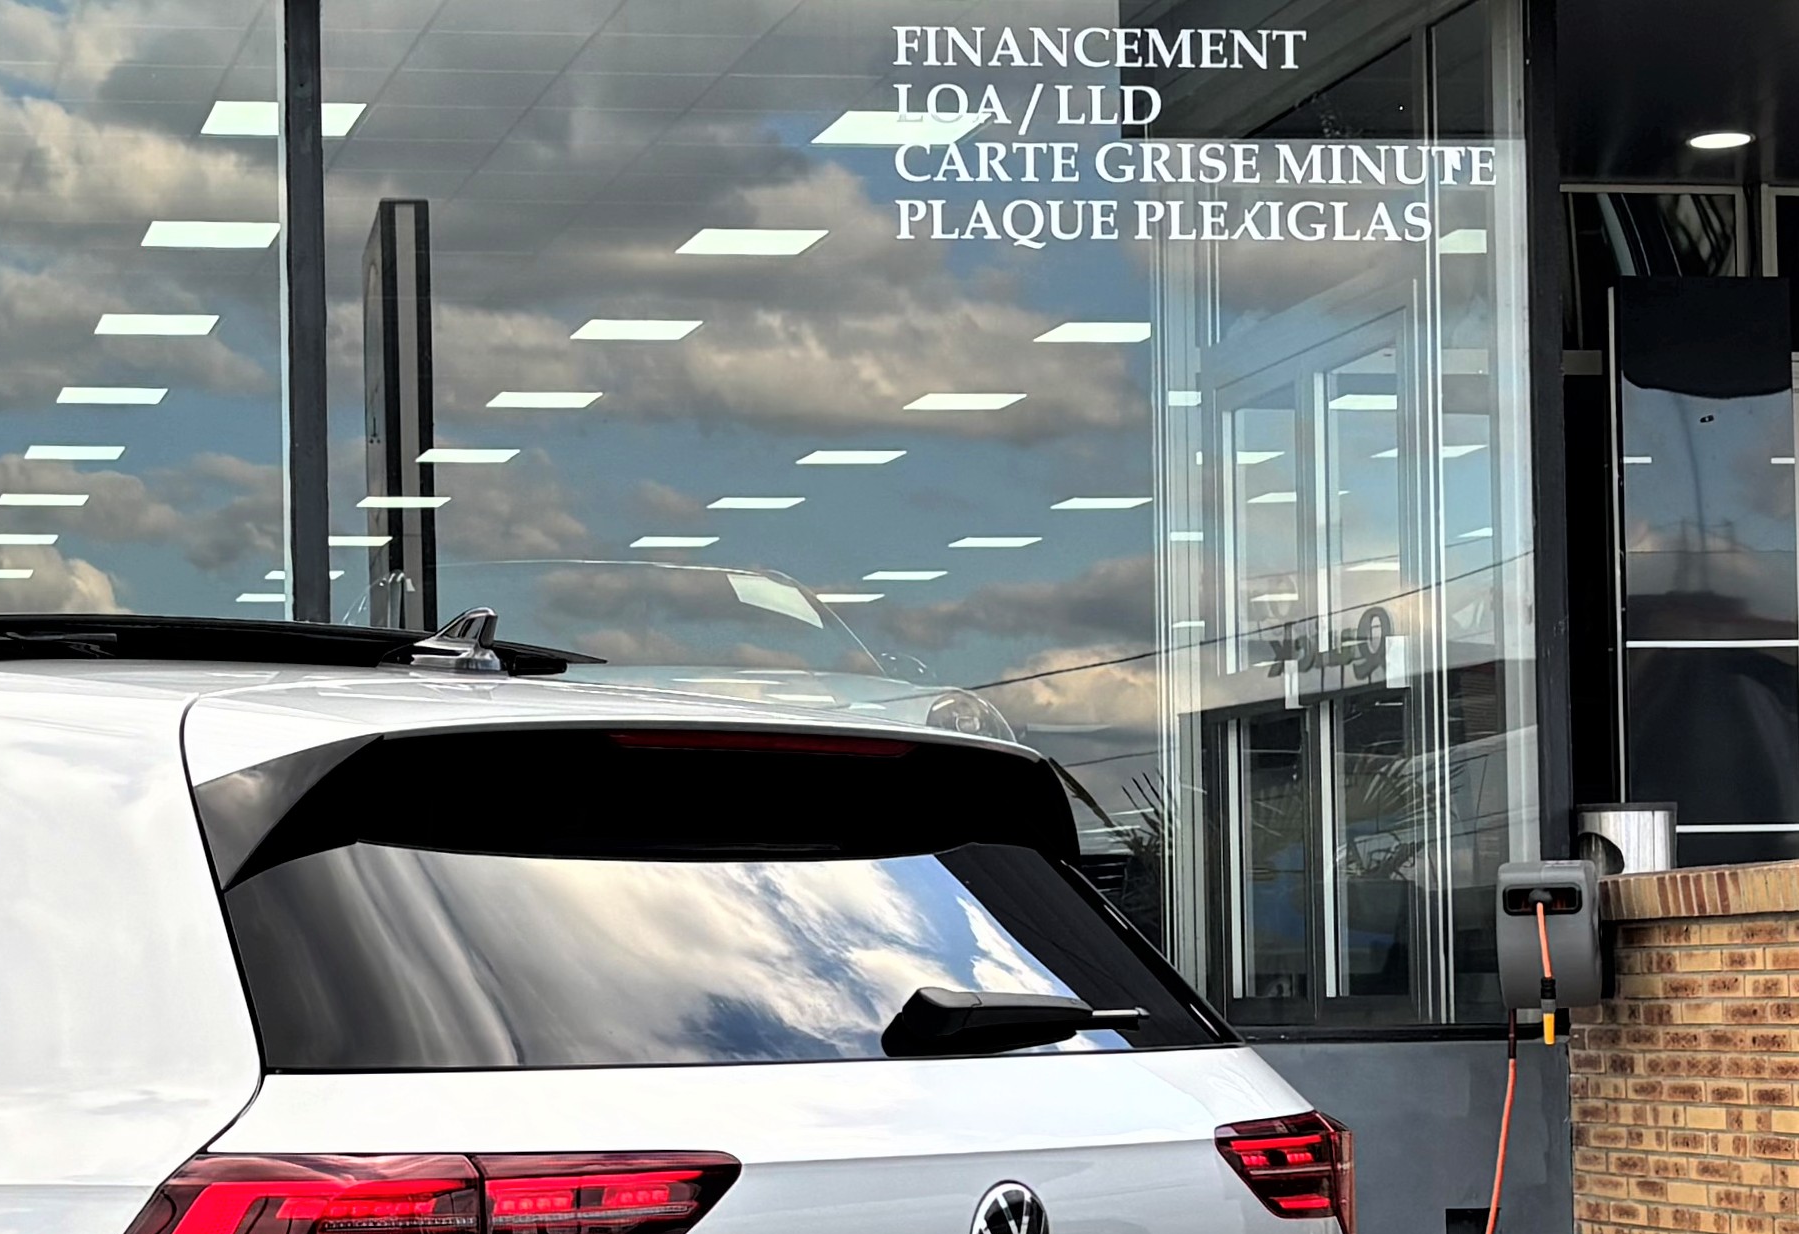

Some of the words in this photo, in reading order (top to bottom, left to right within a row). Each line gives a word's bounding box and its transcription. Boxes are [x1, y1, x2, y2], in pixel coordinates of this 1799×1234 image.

[892, 26, 1307, 69] FINANCEMENT
[894, 83, 1162, 136] LOA/LLD
[894, 142, 1080, 183] CARTE
[1095, 144, 1261, 184] GRISE
[1275, 145, 1498, 186] MINUTE
[895, 199, 1119, 249] PLAQUE
[1134, 201, 1432, 243] PLEXIGLAS
